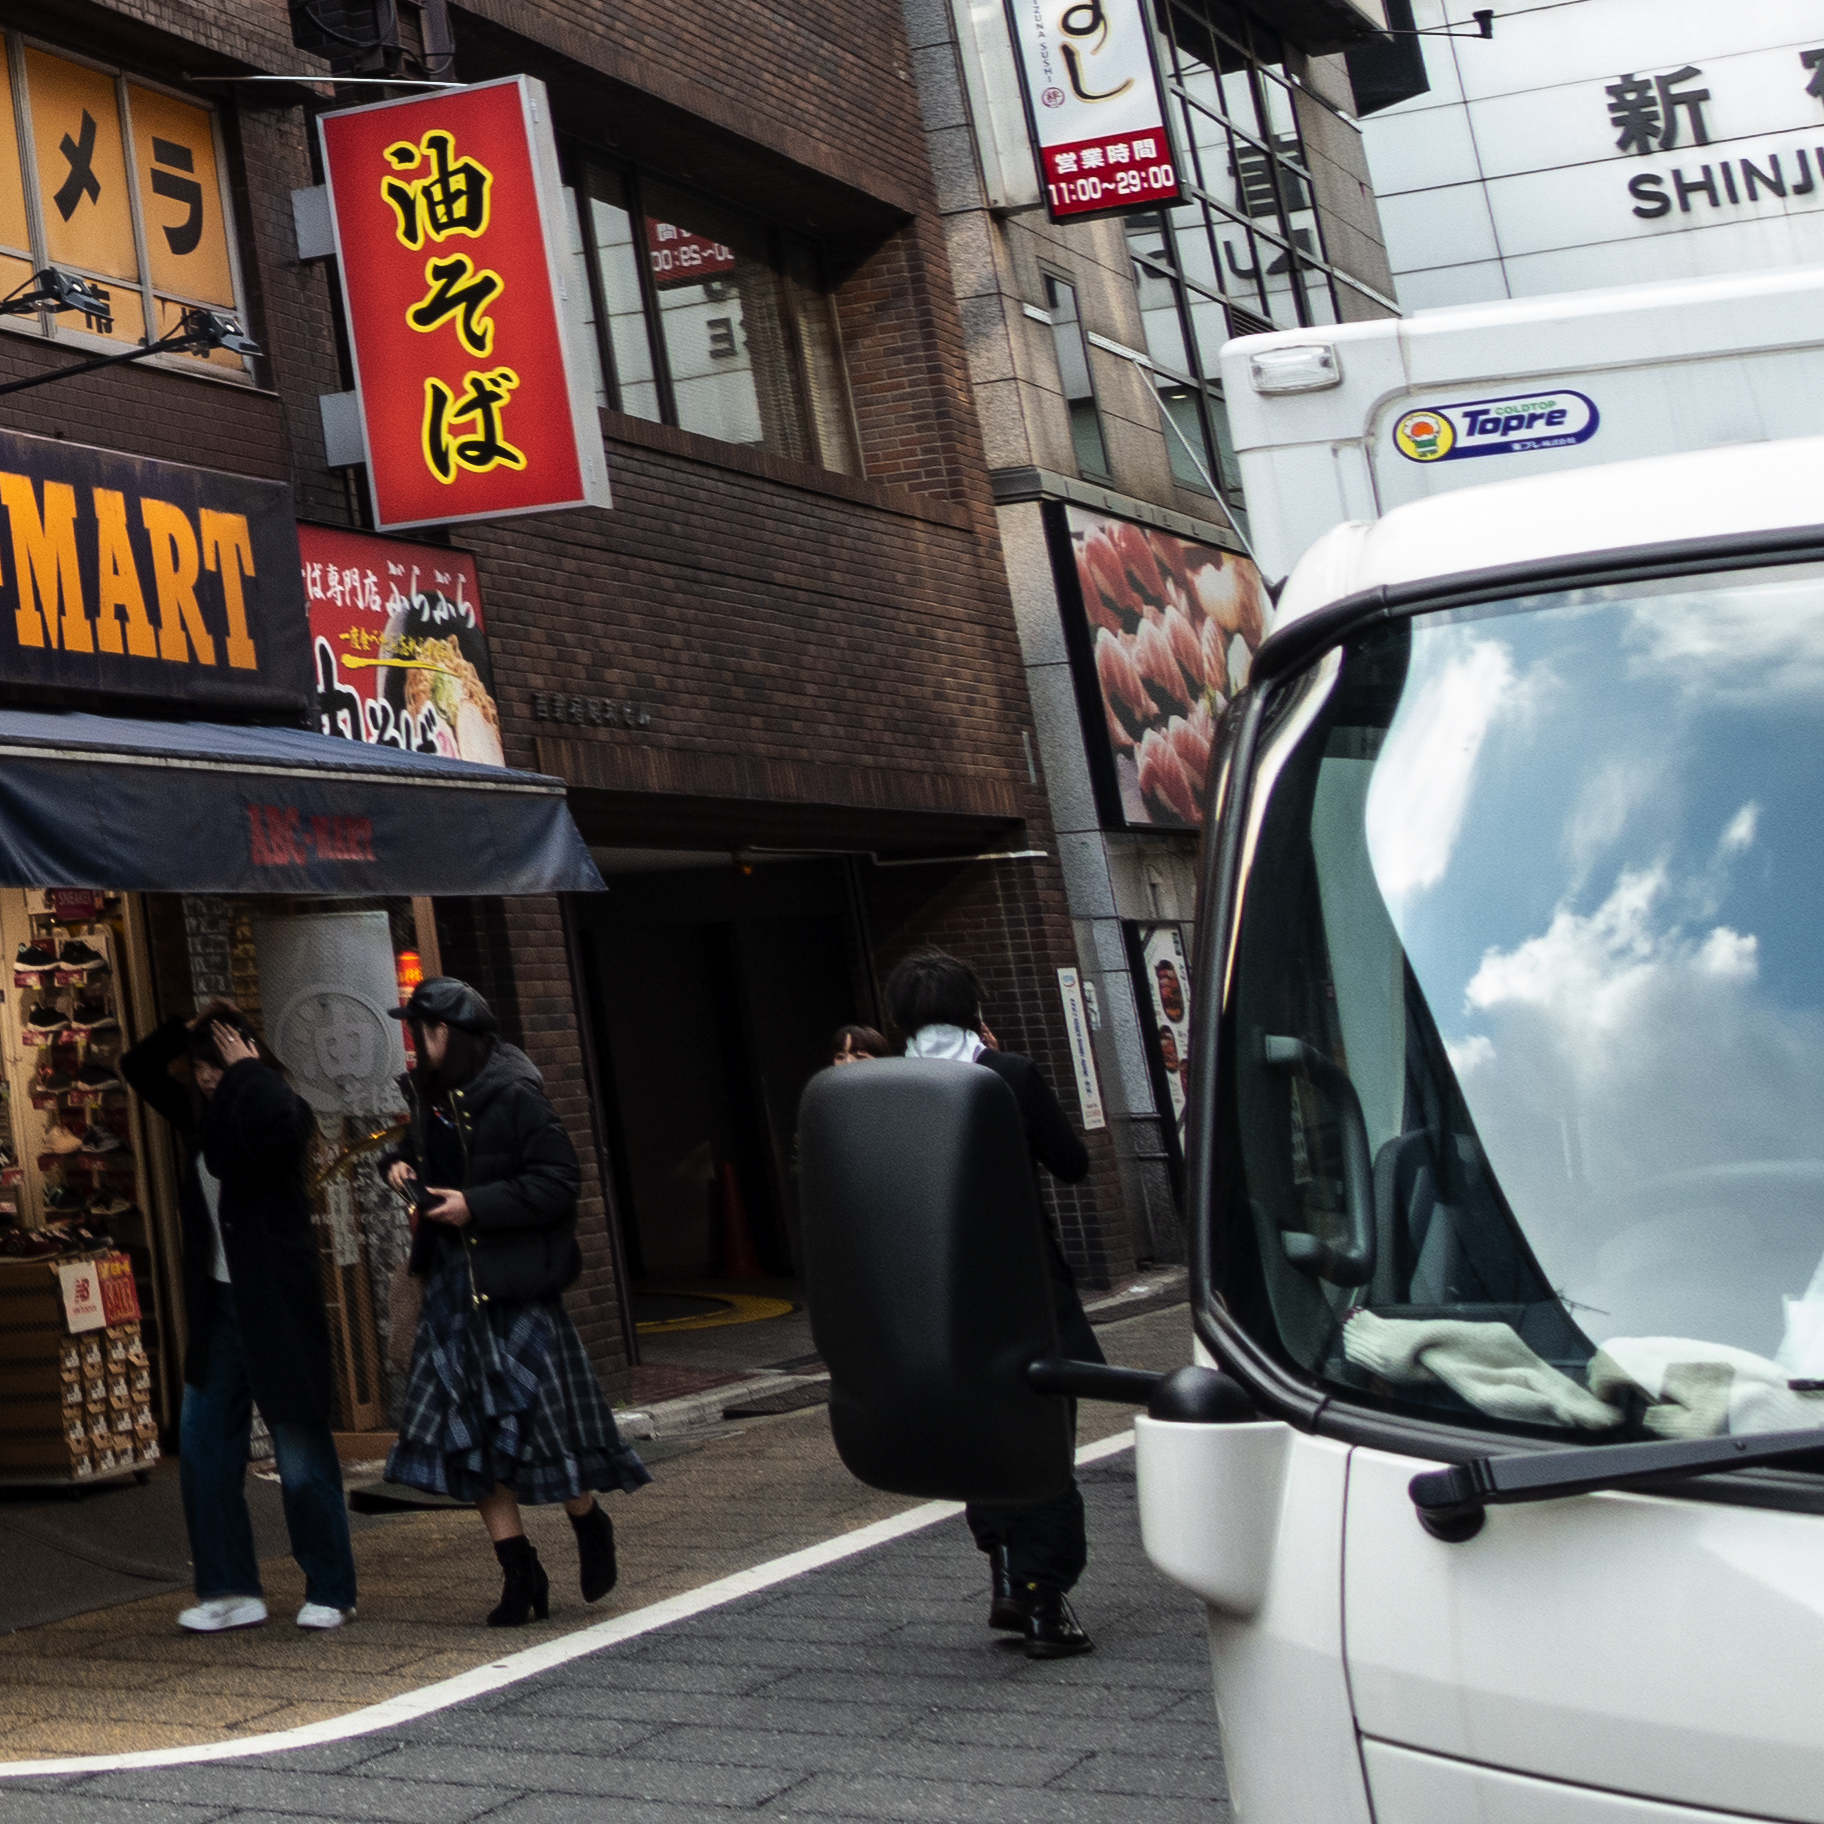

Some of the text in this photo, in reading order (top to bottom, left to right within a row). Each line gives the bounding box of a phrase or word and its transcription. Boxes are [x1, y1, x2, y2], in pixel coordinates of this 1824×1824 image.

[1053, 137, 1158, 175] 営業時間
[381, 126, 529, 486] 油そば
[1461, 408, 1568, 438] Topre
[1494, 400, 1557, 416] COLDTOP
